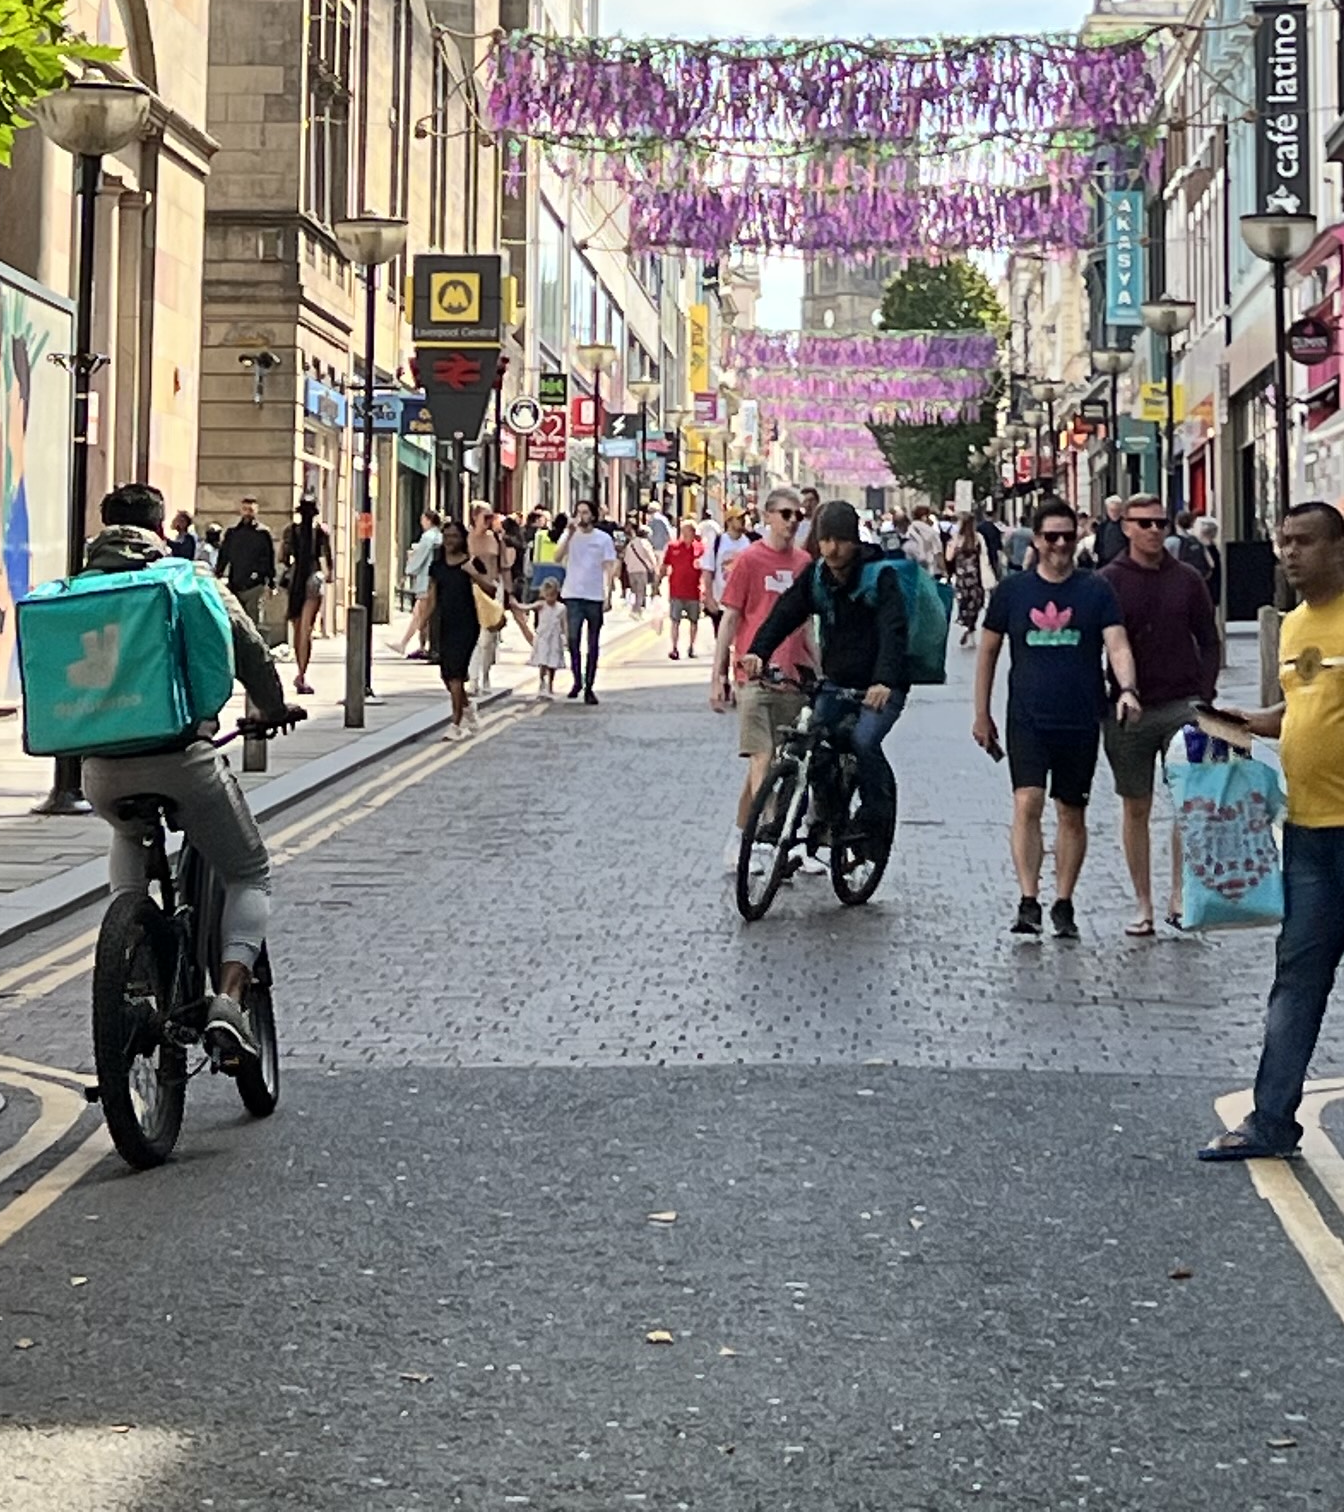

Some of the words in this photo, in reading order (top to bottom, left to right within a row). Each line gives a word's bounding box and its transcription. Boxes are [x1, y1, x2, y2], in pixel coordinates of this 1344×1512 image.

[1266, 13, 1298, 103] latino
[1266, 113, 1299, 178] café
[1116, 198, 1133, 305] AKASYA
